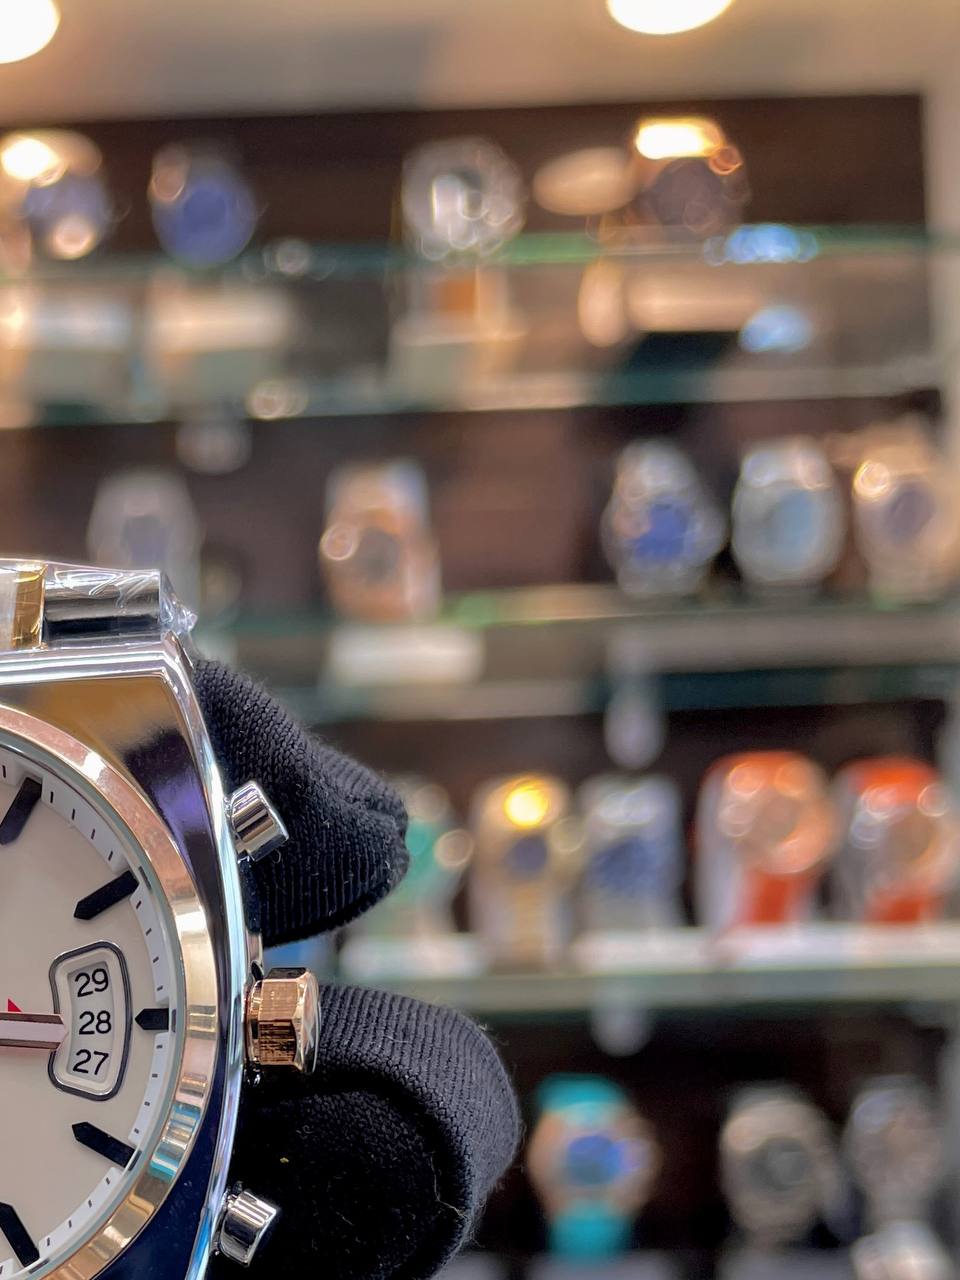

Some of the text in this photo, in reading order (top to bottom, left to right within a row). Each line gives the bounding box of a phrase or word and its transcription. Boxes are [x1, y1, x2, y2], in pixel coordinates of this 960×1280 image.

[74, 968, 109, 998] 29
[78, 1010, 112, 1035] 28
[72, 1049, 109, 1075] 27
